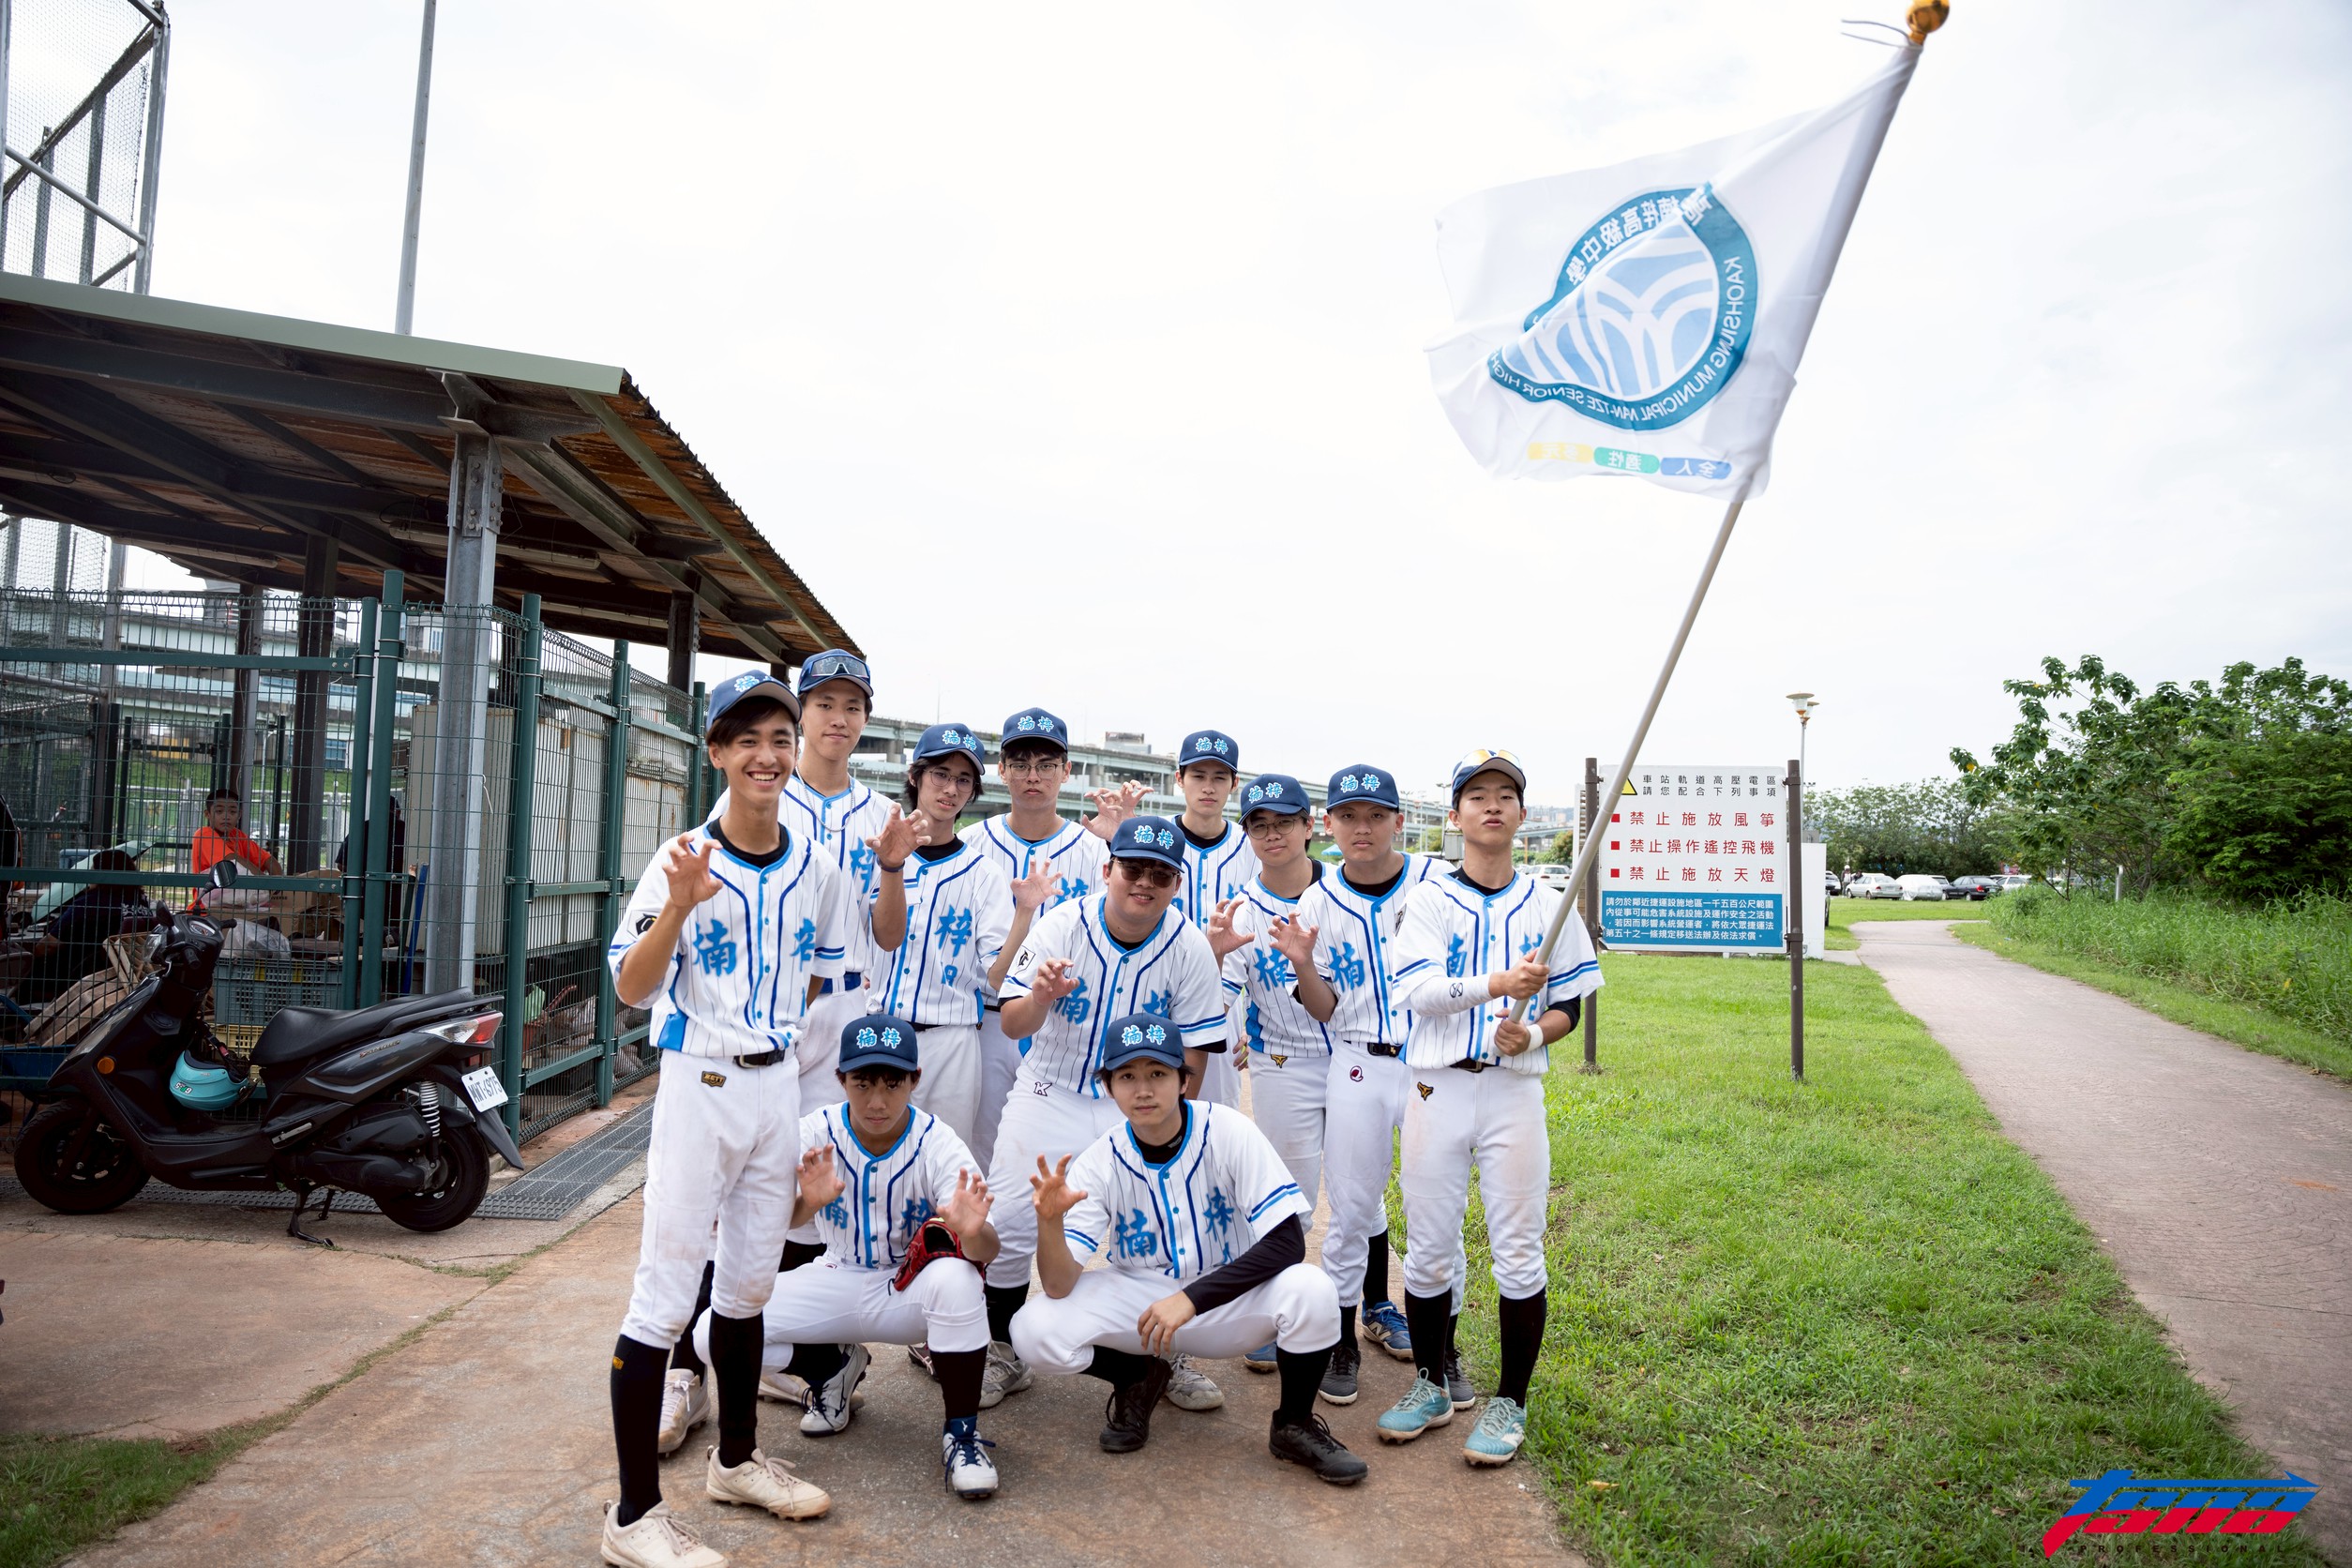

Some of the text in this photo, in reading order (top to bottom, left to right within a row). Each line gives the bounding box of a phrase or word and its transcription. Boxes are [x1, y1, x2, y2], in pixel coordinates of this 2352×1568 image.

[1018, 716, 1055, 733] 楠梓
[1196, 737, 1229, 755] 楠梓
[1340, 773, 1381, 793] 楠梓
[1643, 774, 1776, 785] 車站軌道高壓電區
[1248, 781, 1284, 804] 楠梓
[1643, 786, 1776, 797] 請您配合下列事項
[1630, 811, 1774, 827] 禁止施放風箏
[1134, 824, 1174, 850] 楠梓
[1630, 839, 1775, 855] 禁止操作遙控飛機
[1630, 867, 1775, 882] 禁止施放天燈
[1328, 942, 1365, 993] 楠
[856, 1026, 903, 1049] 楠梓
[1122, 1024, 1168, 1047] 楠梓
[1115, 1207, 1157, 1259] 楠
